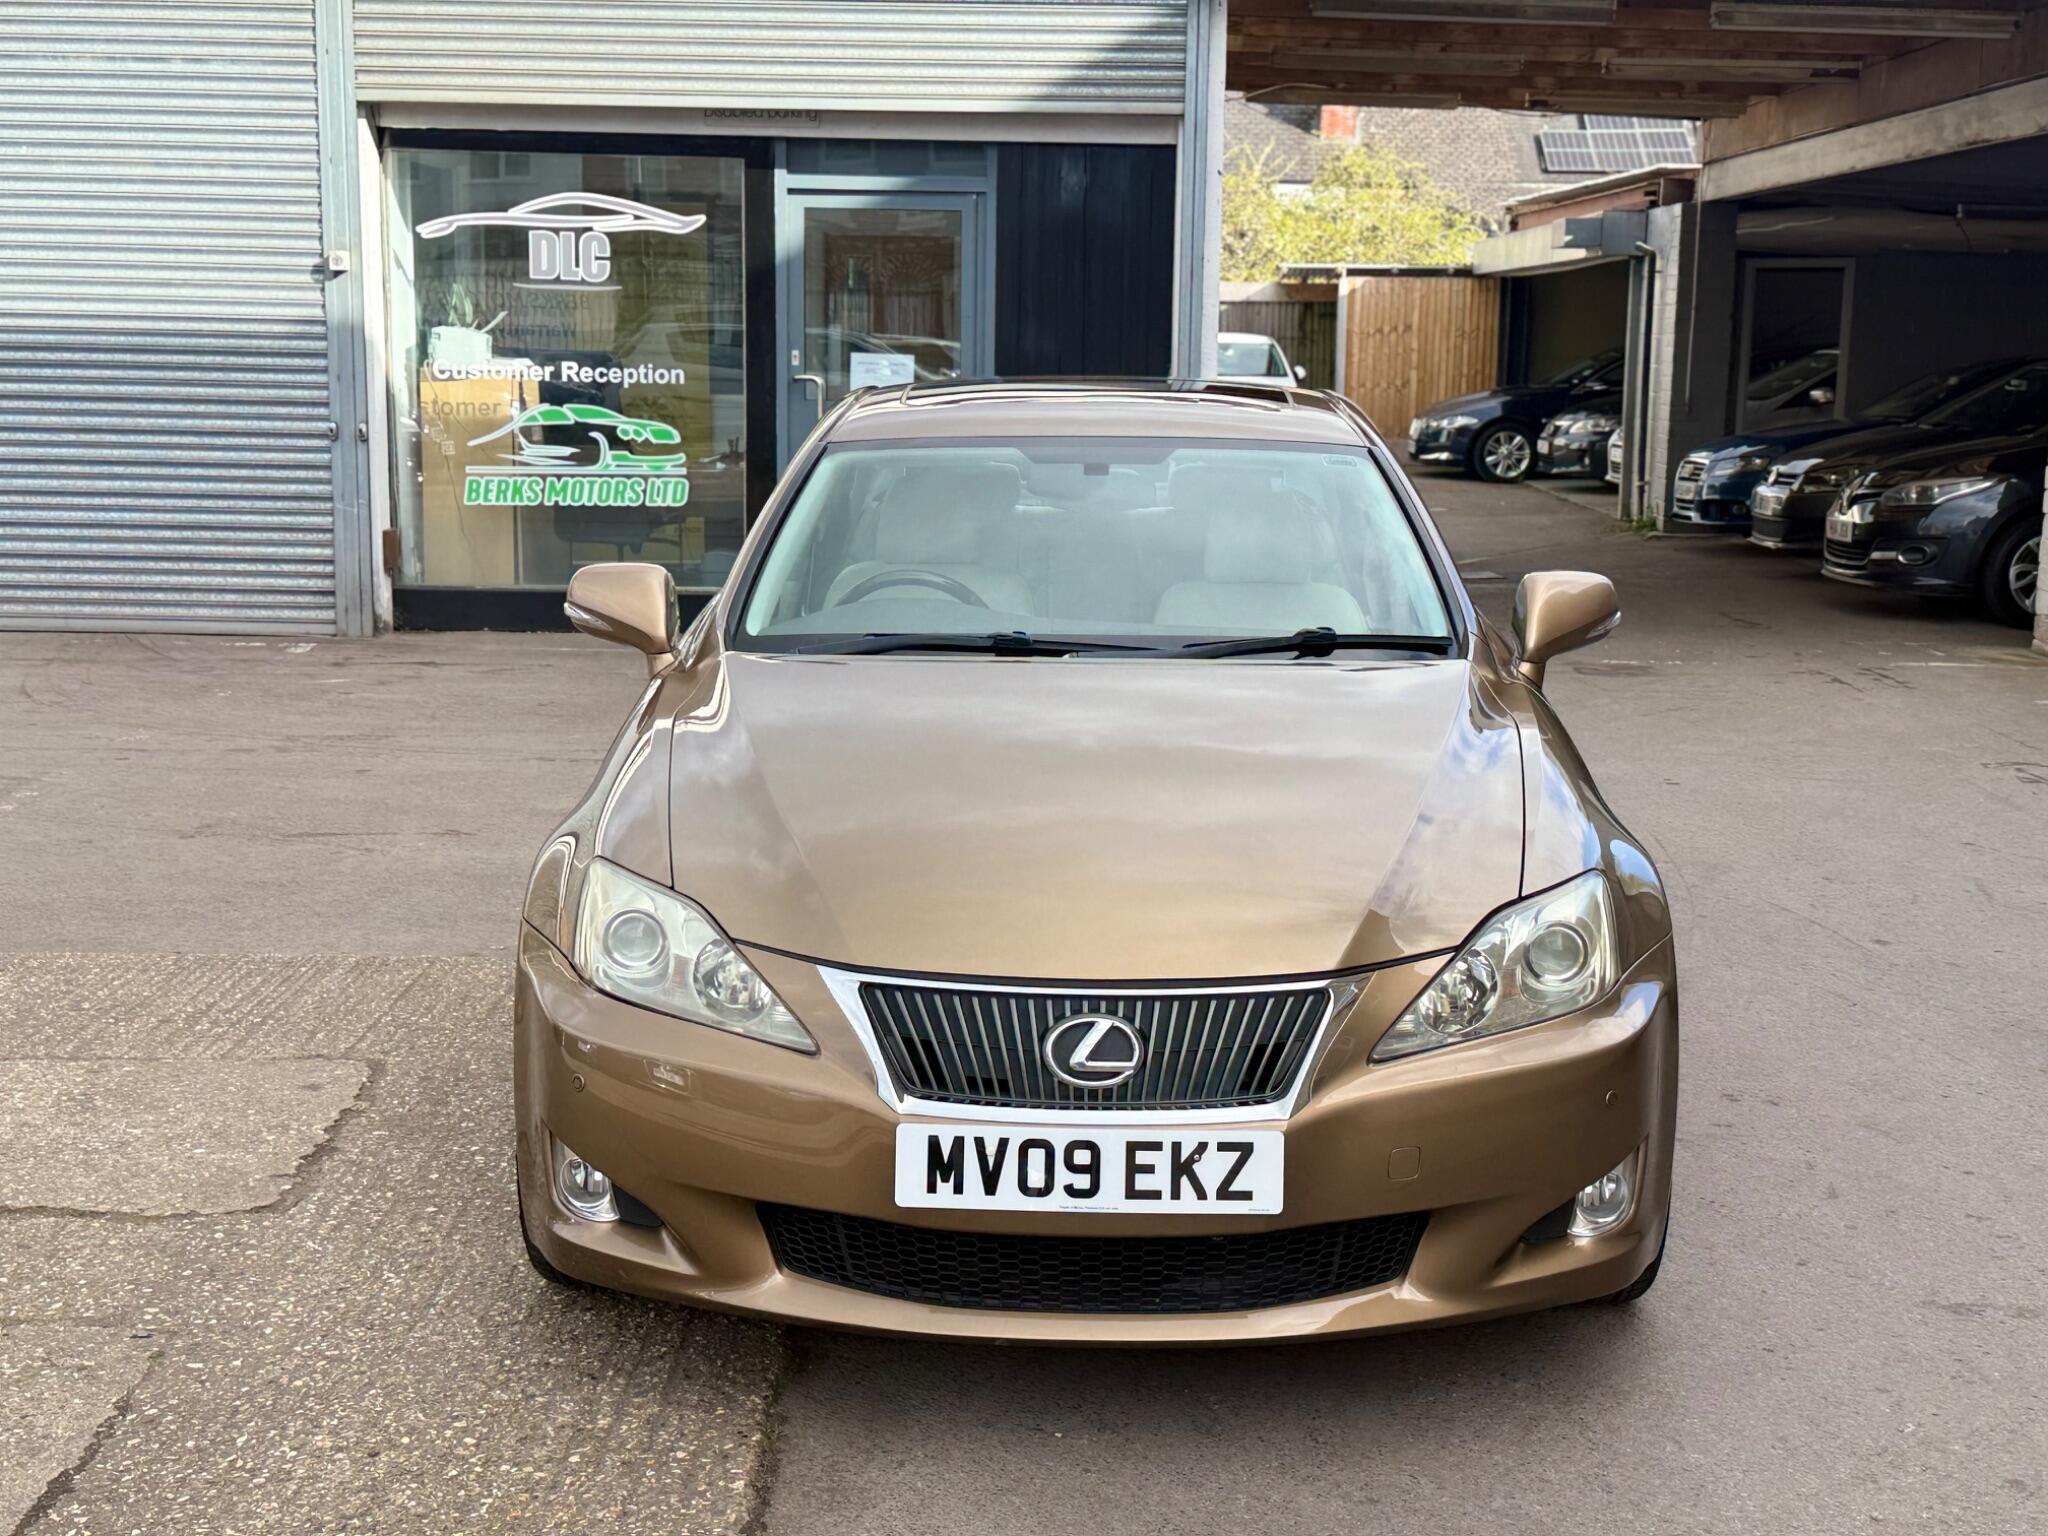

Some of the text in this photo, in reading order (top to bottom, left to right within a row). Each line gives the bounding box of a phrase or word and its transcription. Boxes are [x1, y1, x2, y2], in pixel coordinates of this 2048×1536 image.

[528, 229, 611, 282] DLC
[432, 357, 686, 388] Customer Reception
[464, 476, 690, 507] BERKS MOTORS LTD
[926, 1134, 1255, 1201] MV09 EKZ
